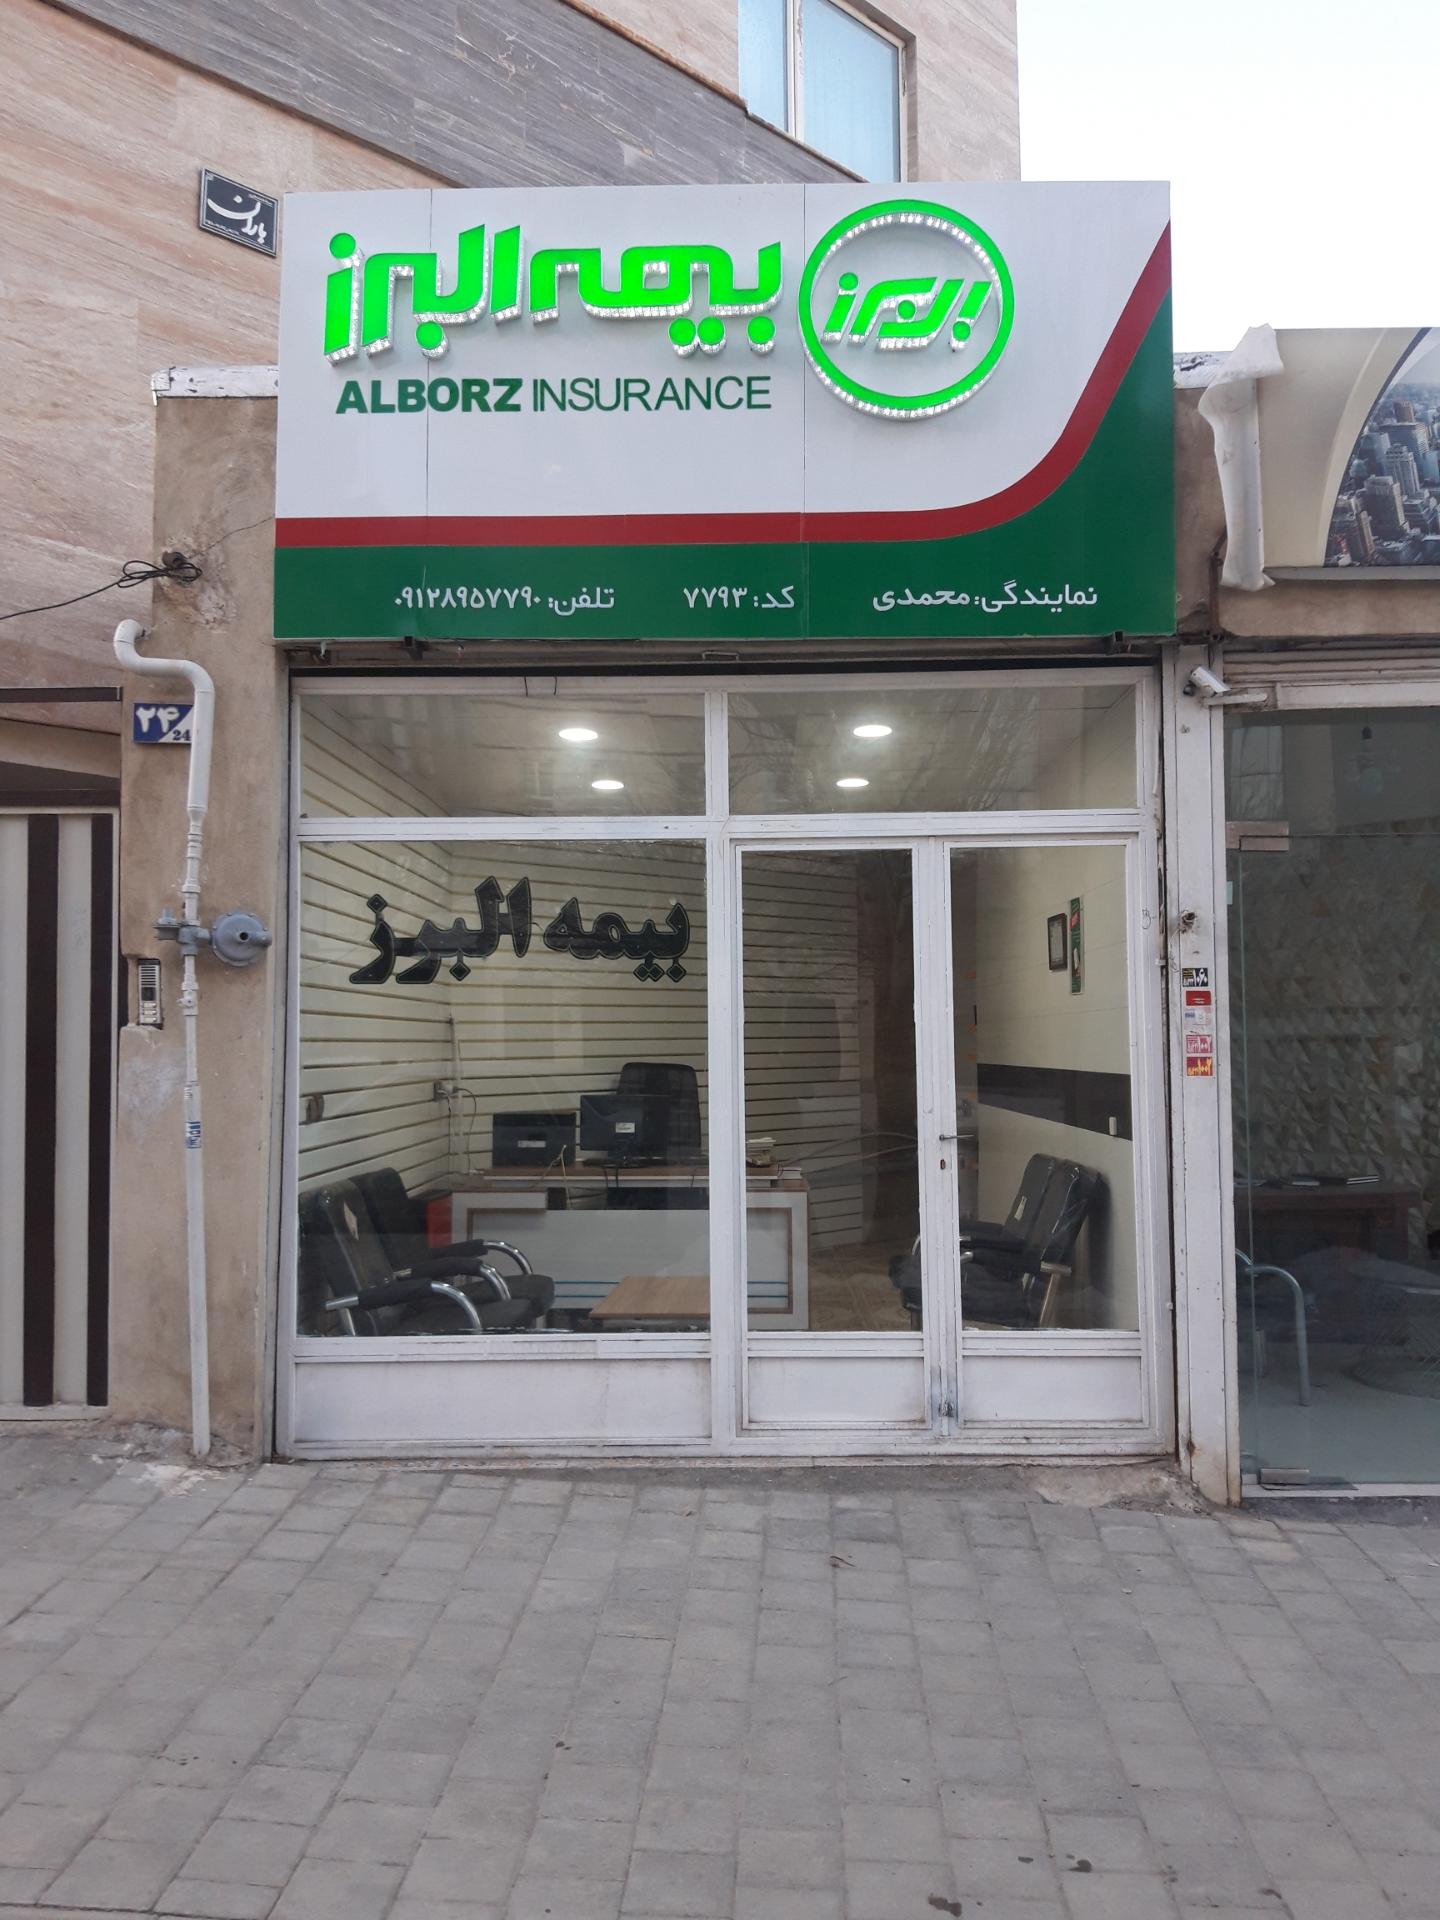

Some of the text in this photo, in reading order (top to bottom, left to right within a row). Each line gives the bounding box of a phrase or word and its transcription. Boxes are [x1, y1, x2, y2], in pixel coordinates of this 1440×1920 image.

[324, 223, 784, 366] بیمه البرز
[335, 375, 772, 415] ALBORZ INSURANCE
[394, 586, 615, 616] تلفن: ۰۹۱۲۸۹۵۷۷۹۰
[682, 585, 796, 609] کد: ۷۷۹۳
[872, 586, 970, 612] محمدی
[135, 706, 181, 734] ۲۴
[172, 729, 191, 741] 24
[349, 875, 691, 984] بیمه البرز
